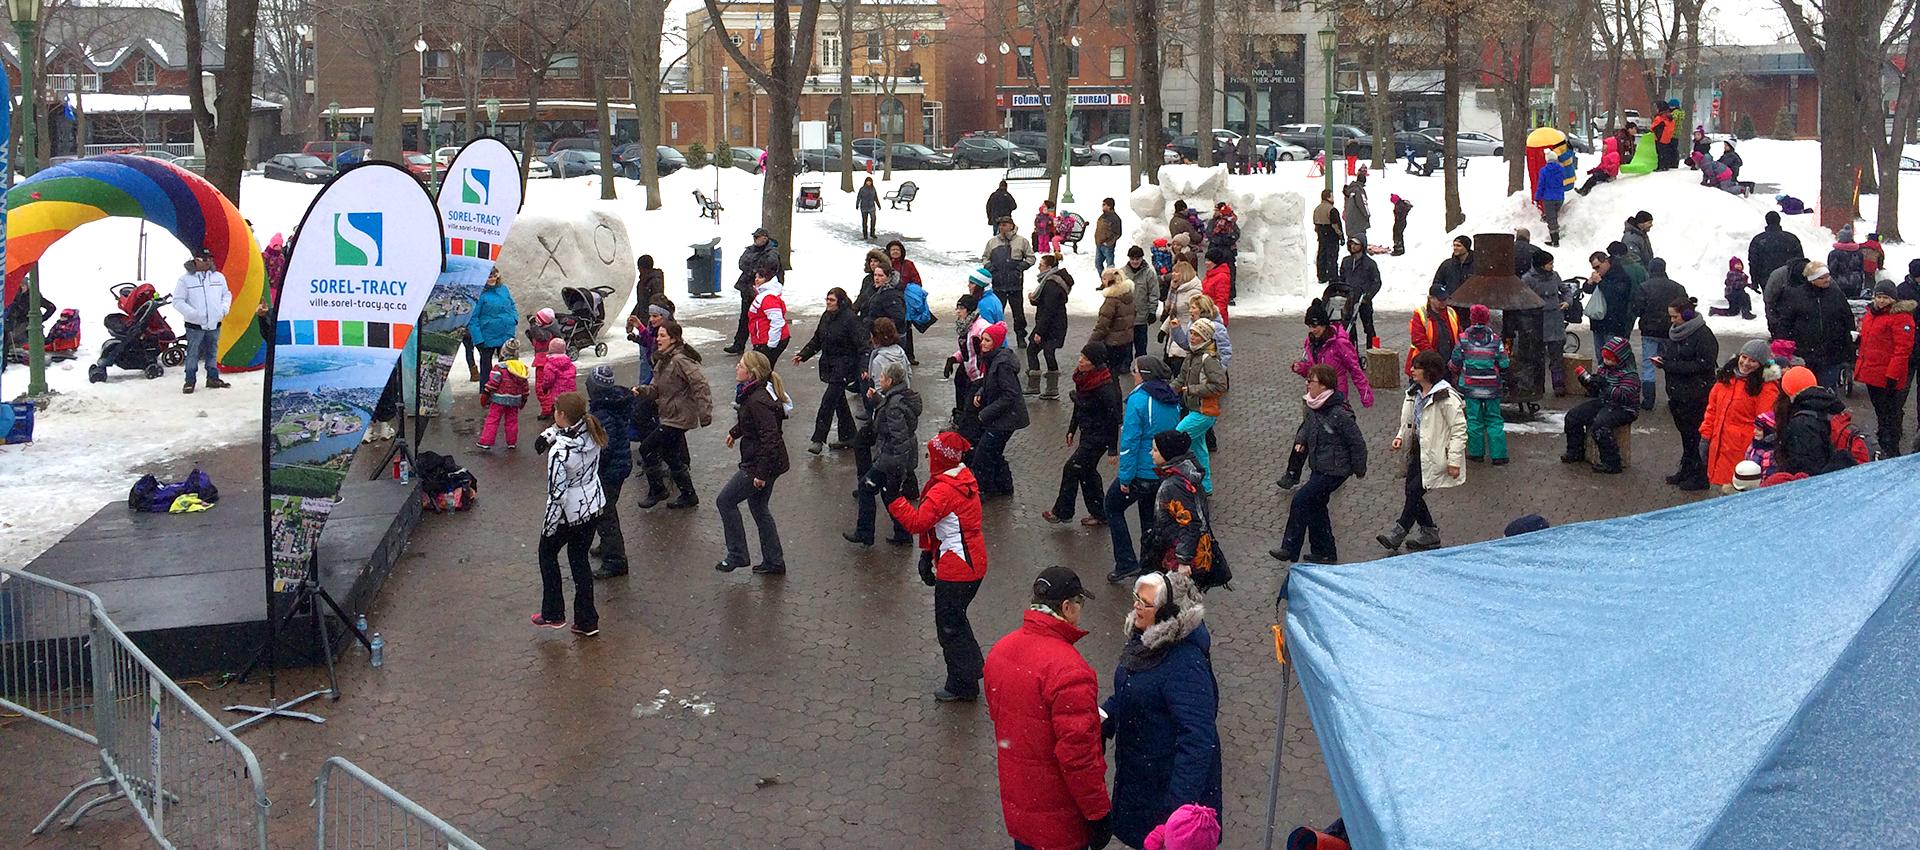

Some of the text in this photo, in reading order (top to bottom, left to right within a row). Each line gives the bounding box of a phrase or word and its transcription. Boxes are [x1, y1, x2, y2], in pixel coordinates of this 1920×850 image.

[1078, 95, 1108, 104] BUREAU
[448, 210, 501, 226] SOREL-TRACY
[310, 279, 407, 296] SOREL-TRACY
[309, 299, 408, 311] ville.sorel-tracy.qc.ca
